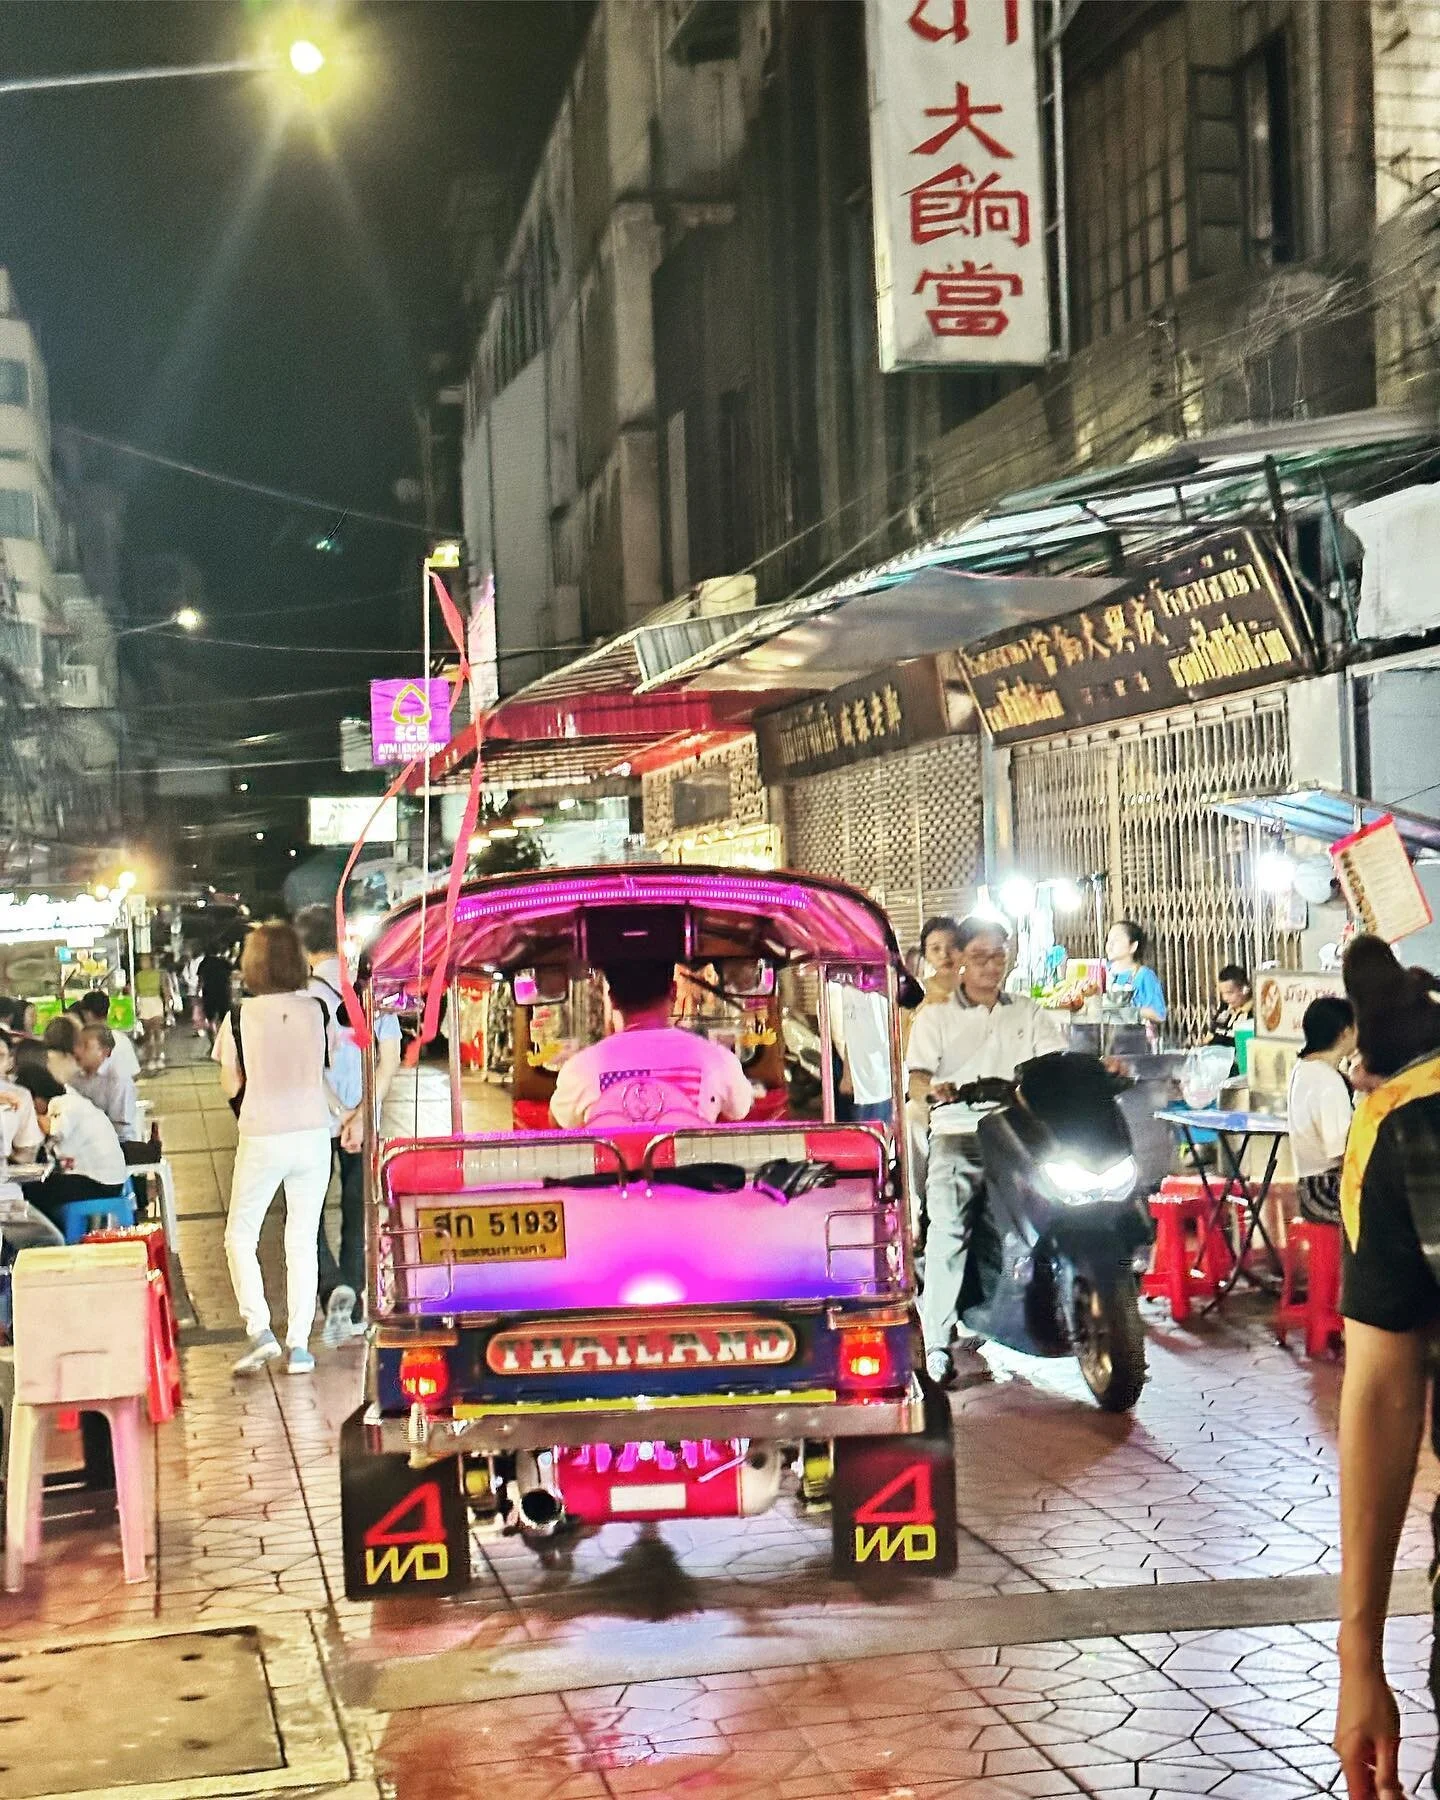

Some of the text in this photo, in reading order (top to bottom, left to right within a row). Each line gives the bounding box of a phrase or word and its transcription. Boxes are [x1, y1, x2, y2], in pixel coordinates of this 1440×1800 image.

[901, 81, 1030, 337] 大餉當
[378, 743, 397, 754] ATM
[395, 725, 428, 742] SCB
[489, 1210, 559, 1237] 5193
[498, 1329, 792, 1369] THAILAND
[853, 1462, 936, 1524] 4
[364, 1482, 447, 1546] 4
